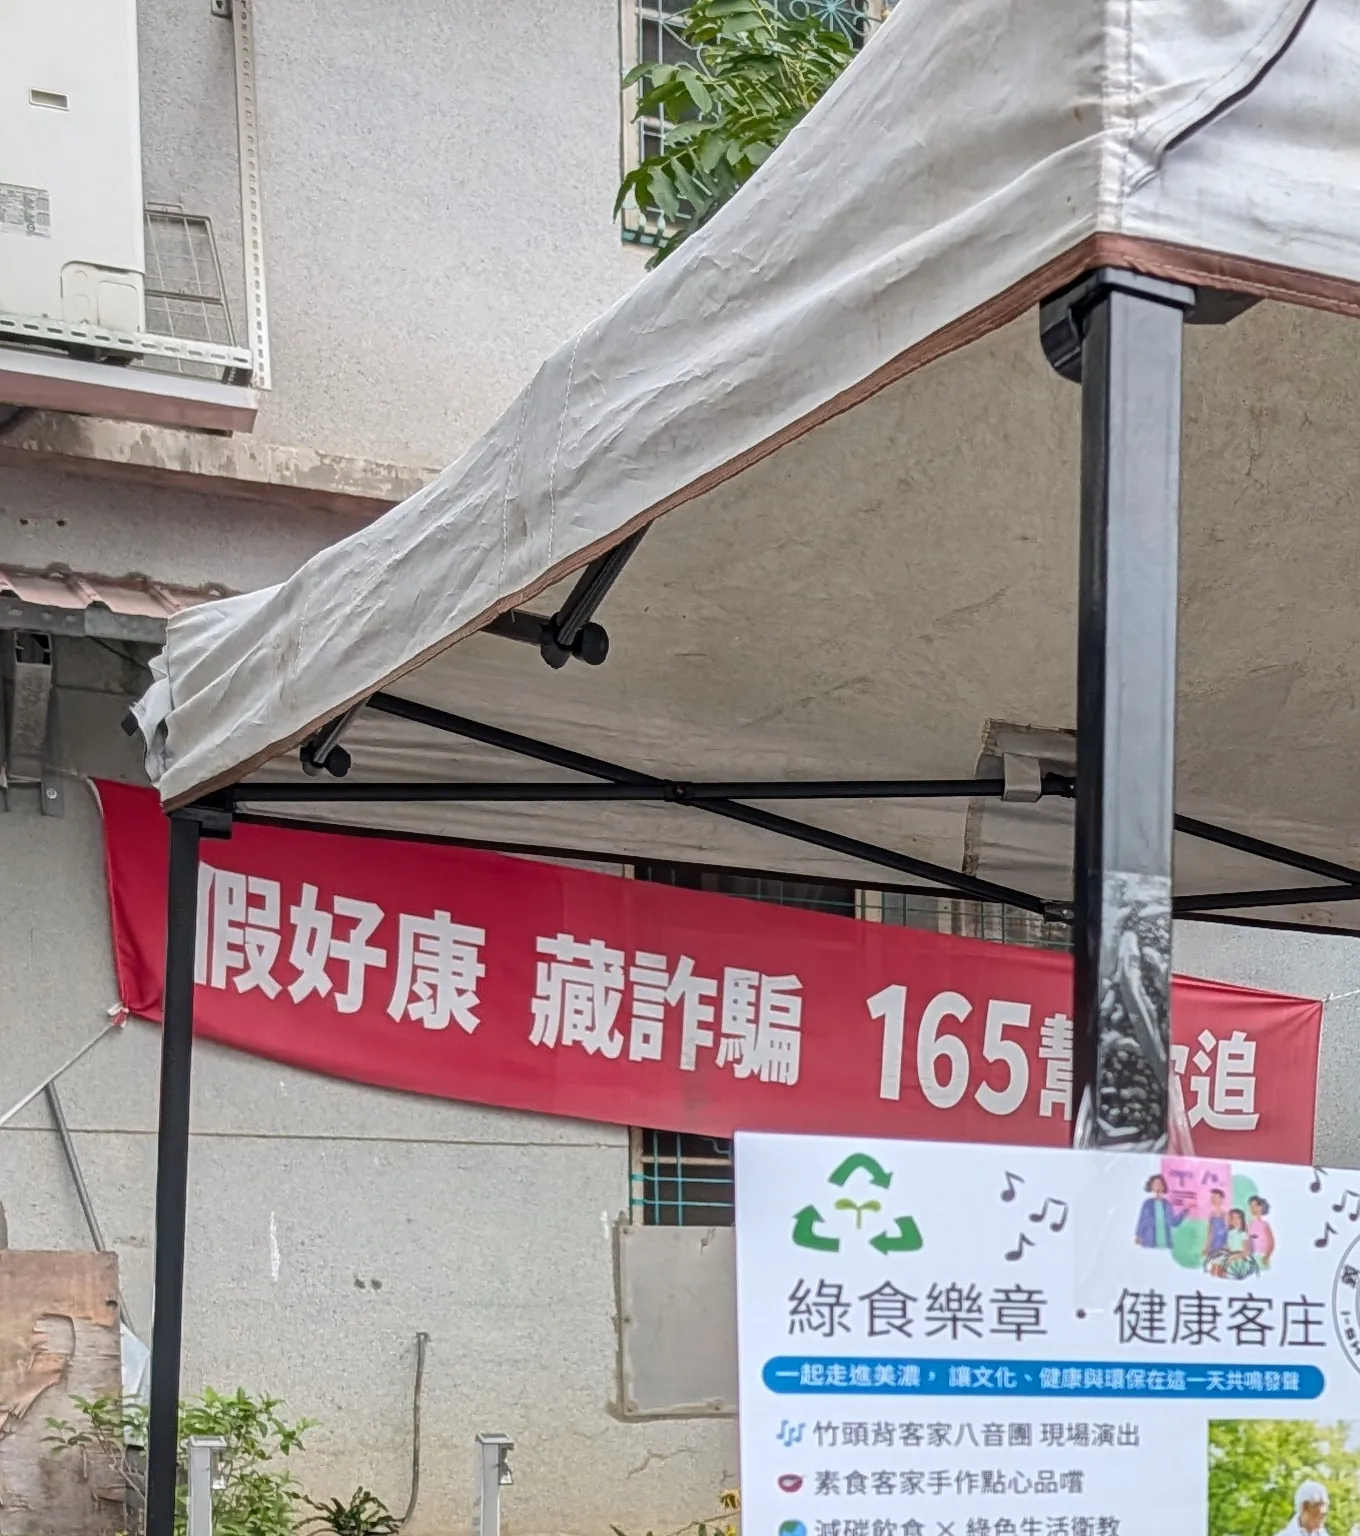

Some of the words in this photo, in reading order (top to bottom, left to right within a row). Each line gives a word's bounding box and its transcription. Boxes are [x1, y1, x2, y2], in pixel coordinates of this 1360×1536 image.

[194, 860, 486, 1034] 假好康
[529, 933, 803, 1086] 藏詐騙
[866, 982, 1260, 1132] 165追
[813, 1420, 1033, 1449] 竹頭背客家八音團
[1040, 1422, 1140, 1448] 現場演出
